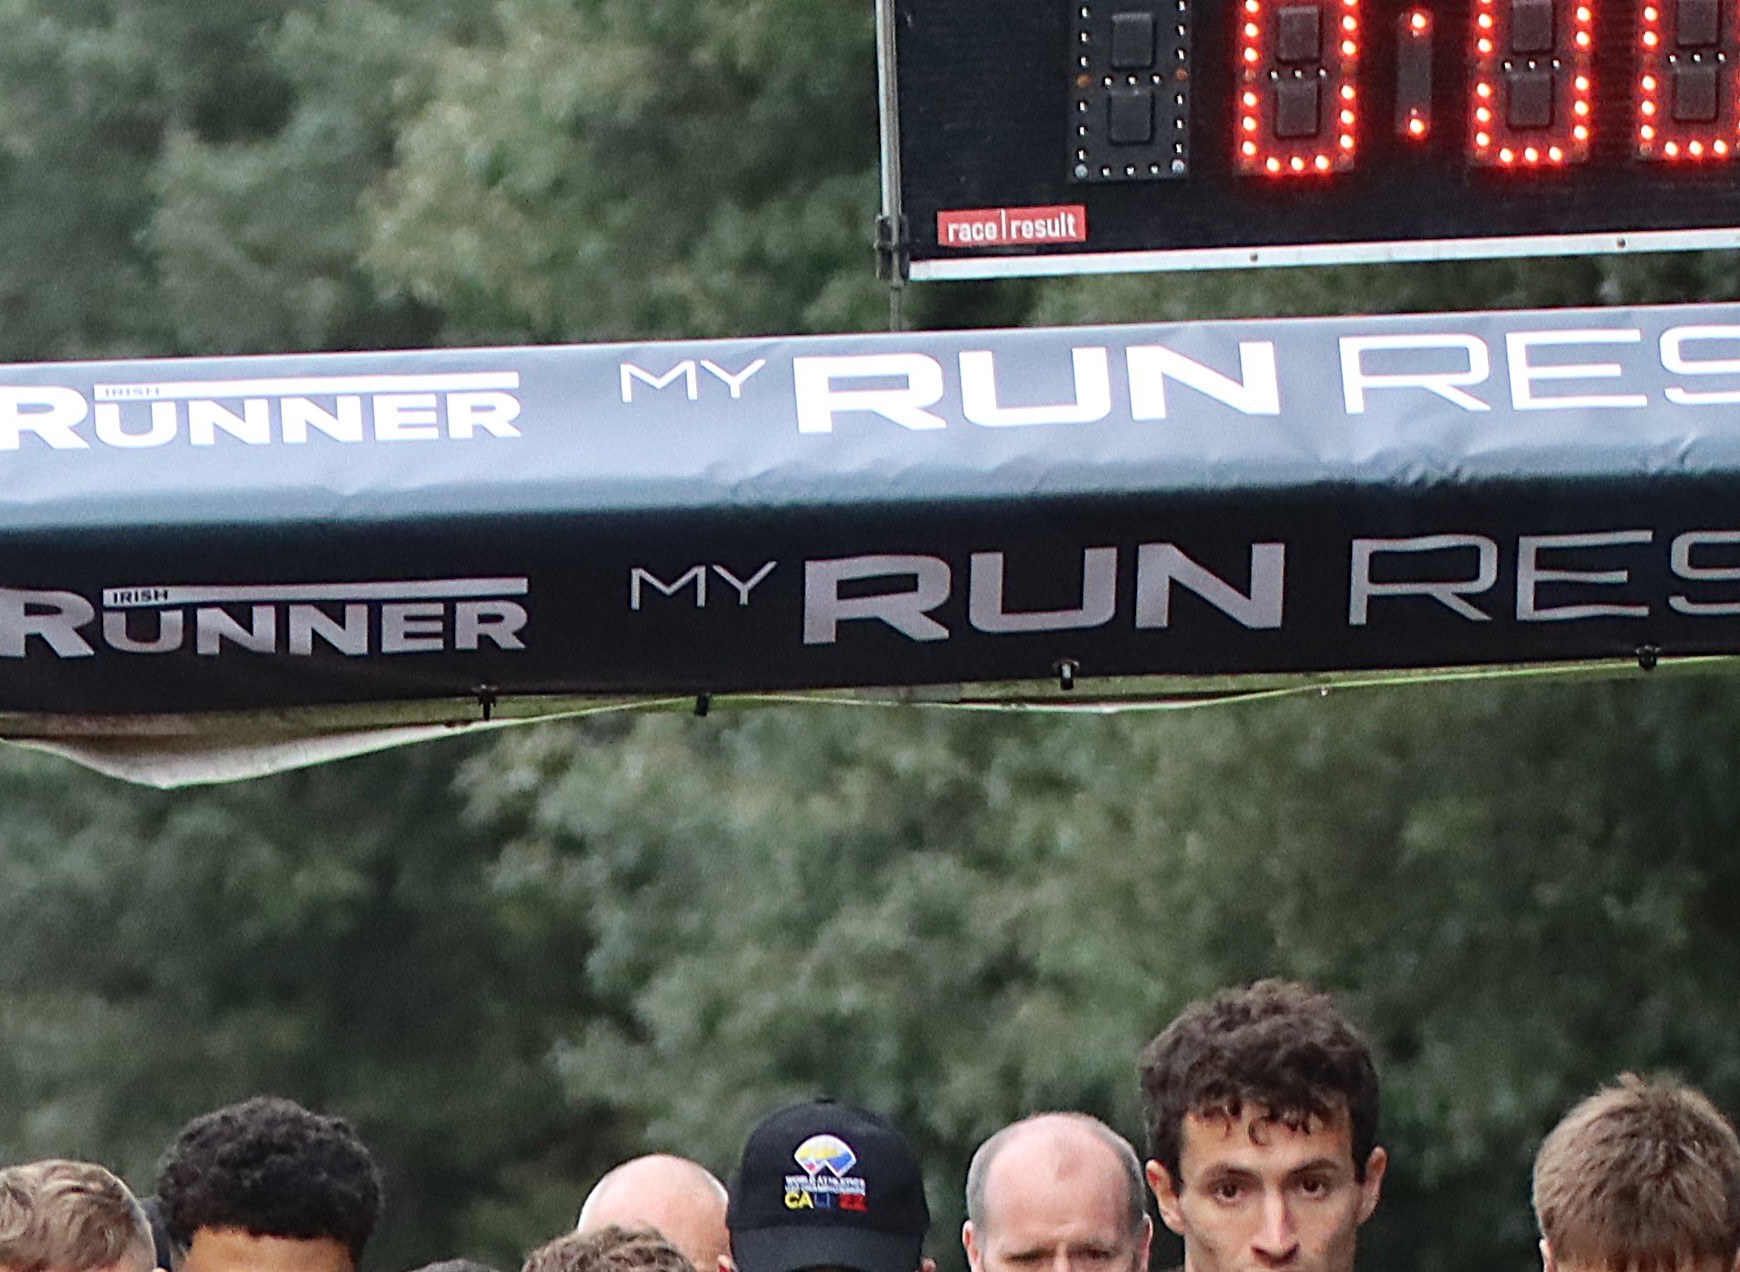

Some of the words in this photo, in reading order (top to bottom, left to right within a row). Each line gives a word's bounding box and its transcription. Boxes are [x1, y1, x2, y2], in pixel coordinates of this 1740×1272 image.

[621, 358, 767, 404] MY
[795, 341, 1280, 435] RUN
[111, 588, 170, 603] IRISH
[630, 560, 777, 610] MY
[803, 543, 1286, 646] RUN
